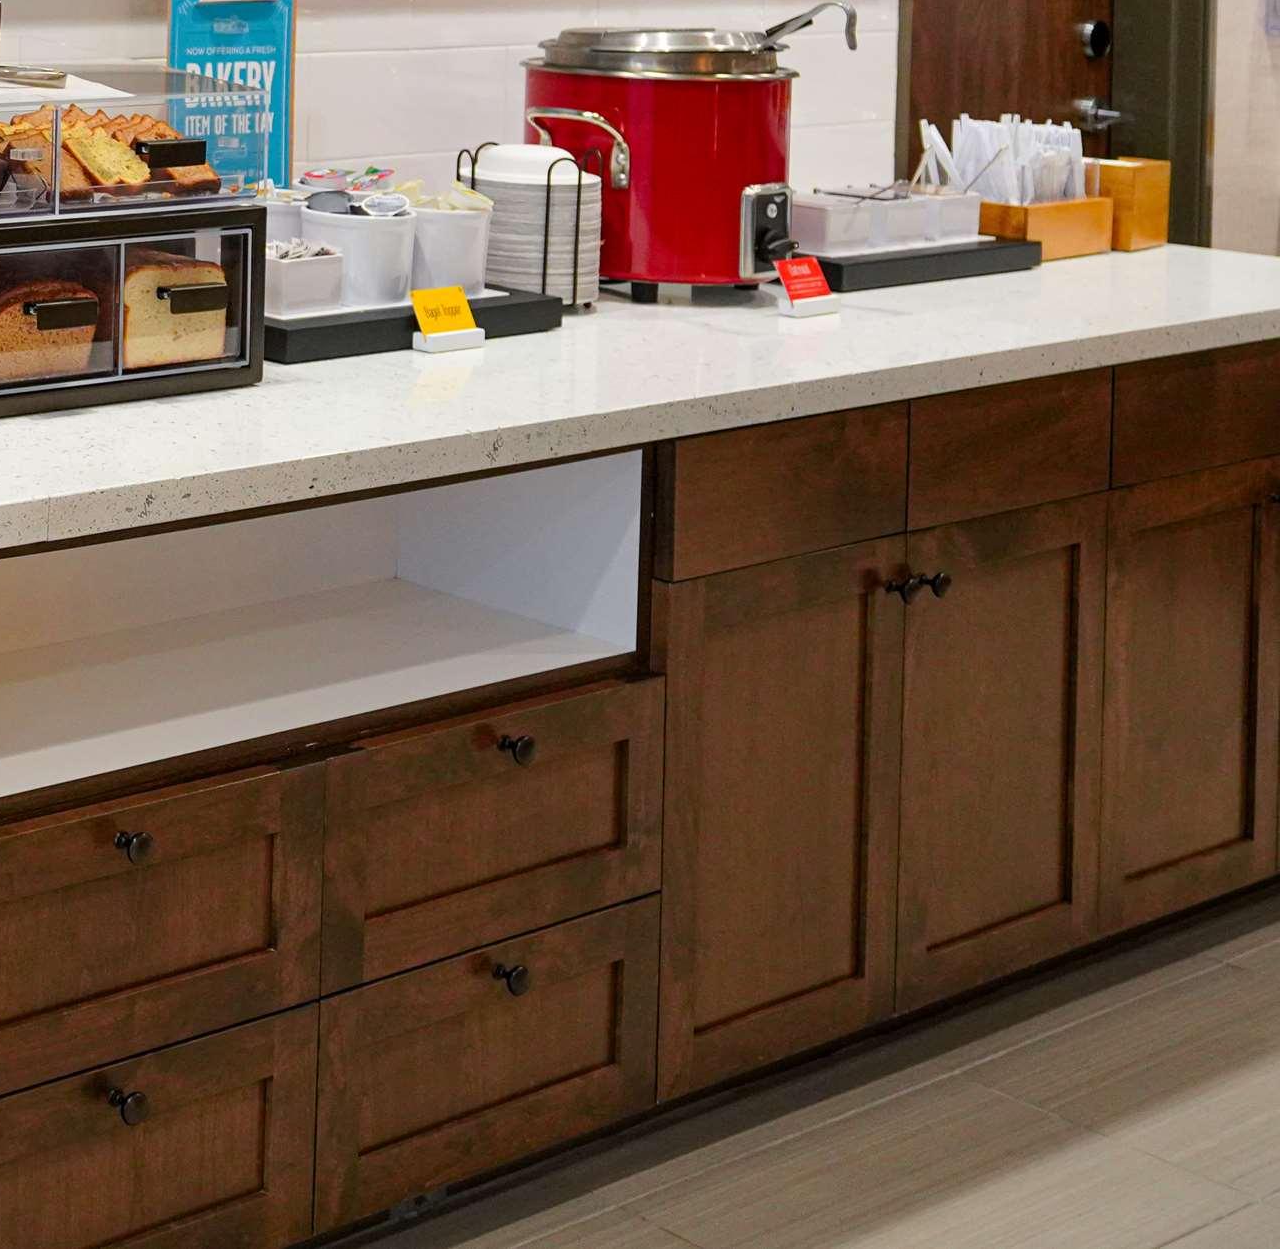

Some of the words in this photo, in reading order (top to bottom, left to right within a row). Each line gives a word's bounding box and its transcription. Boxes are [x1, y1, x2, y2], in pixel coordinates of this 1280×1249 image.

[186, 47, 205, 56] NOW
[205, 47, 244, 56] OFFERING
[185, 60, 277, 108] BAKERY
[185, 114, 211, 137] ITEM
[215, 113, 229, 135] OF
[232, 112, 251, 135] THE
